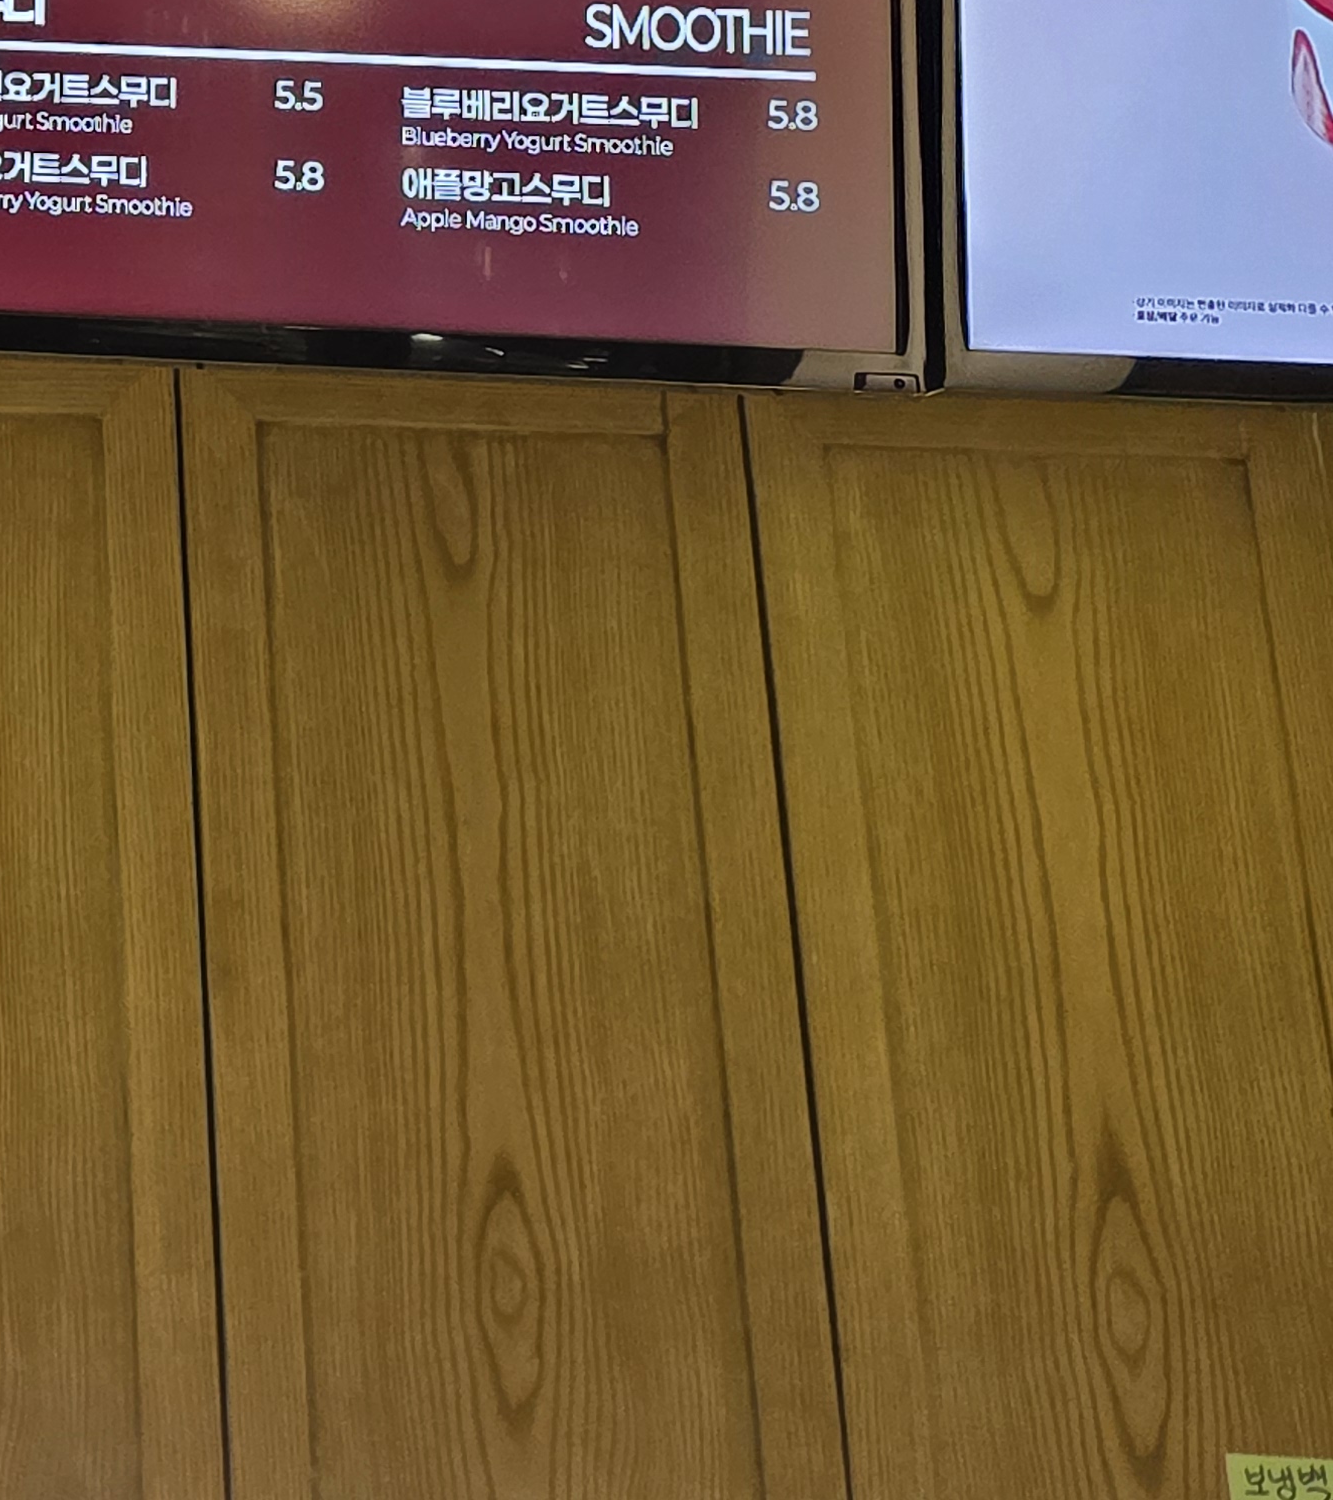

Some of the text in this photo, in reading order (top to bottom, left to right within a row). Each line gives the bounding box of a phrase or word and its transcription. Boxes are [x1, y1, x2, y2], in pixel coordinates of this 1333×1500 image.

[584, 3, 811, 57] SMOOTHIE
[400, 86, 698, 130] 블루베리요거트스무디
[401, 167, 610, 208] 애플망고스무디
[399, 206, 639, 236] Apple Mango Smoothie
